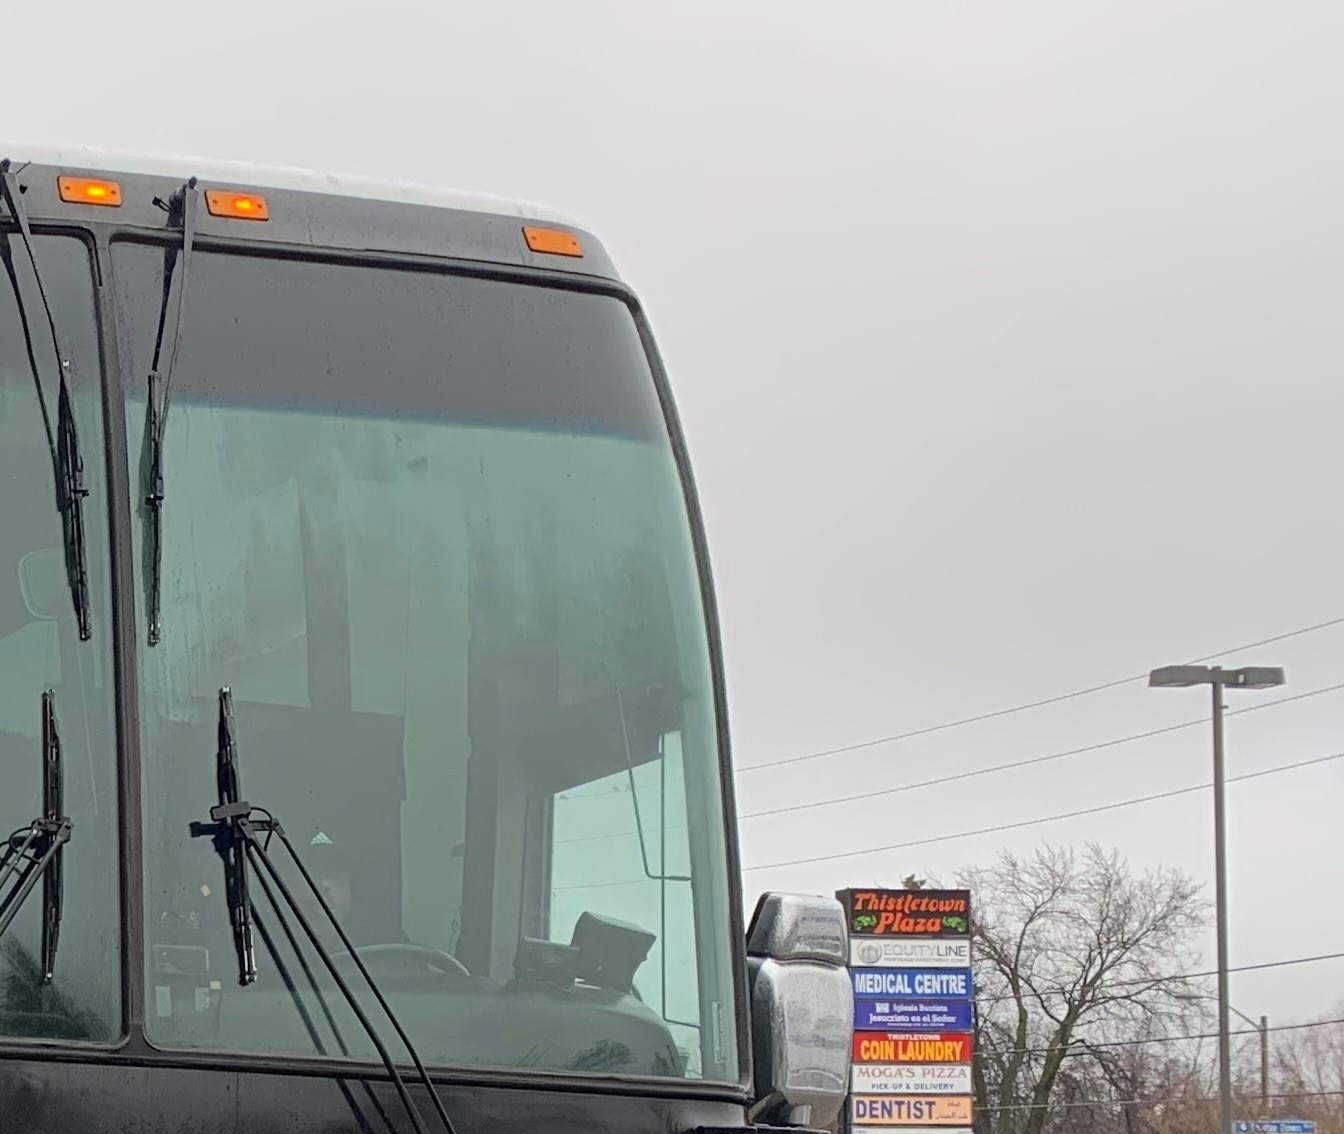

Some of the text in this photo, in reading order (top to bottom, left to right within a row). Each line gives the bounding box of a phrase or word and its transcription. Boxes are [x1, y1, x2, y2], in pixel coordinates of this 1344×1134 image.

[854, 892, 966, 914] Thistletown
[873, 912, 941, 934] Plaza
[883, 944, 967, 957] EQUITYLINE
[855, 974, 966, 994] MEDICAL CENTRE
[860, 1040, 963, 1062] COIN LAUNDRY
[857, 1067, 967, 1078] MOGA'S PIZZA
[855, 1100, 936, 1119] DENTIST
